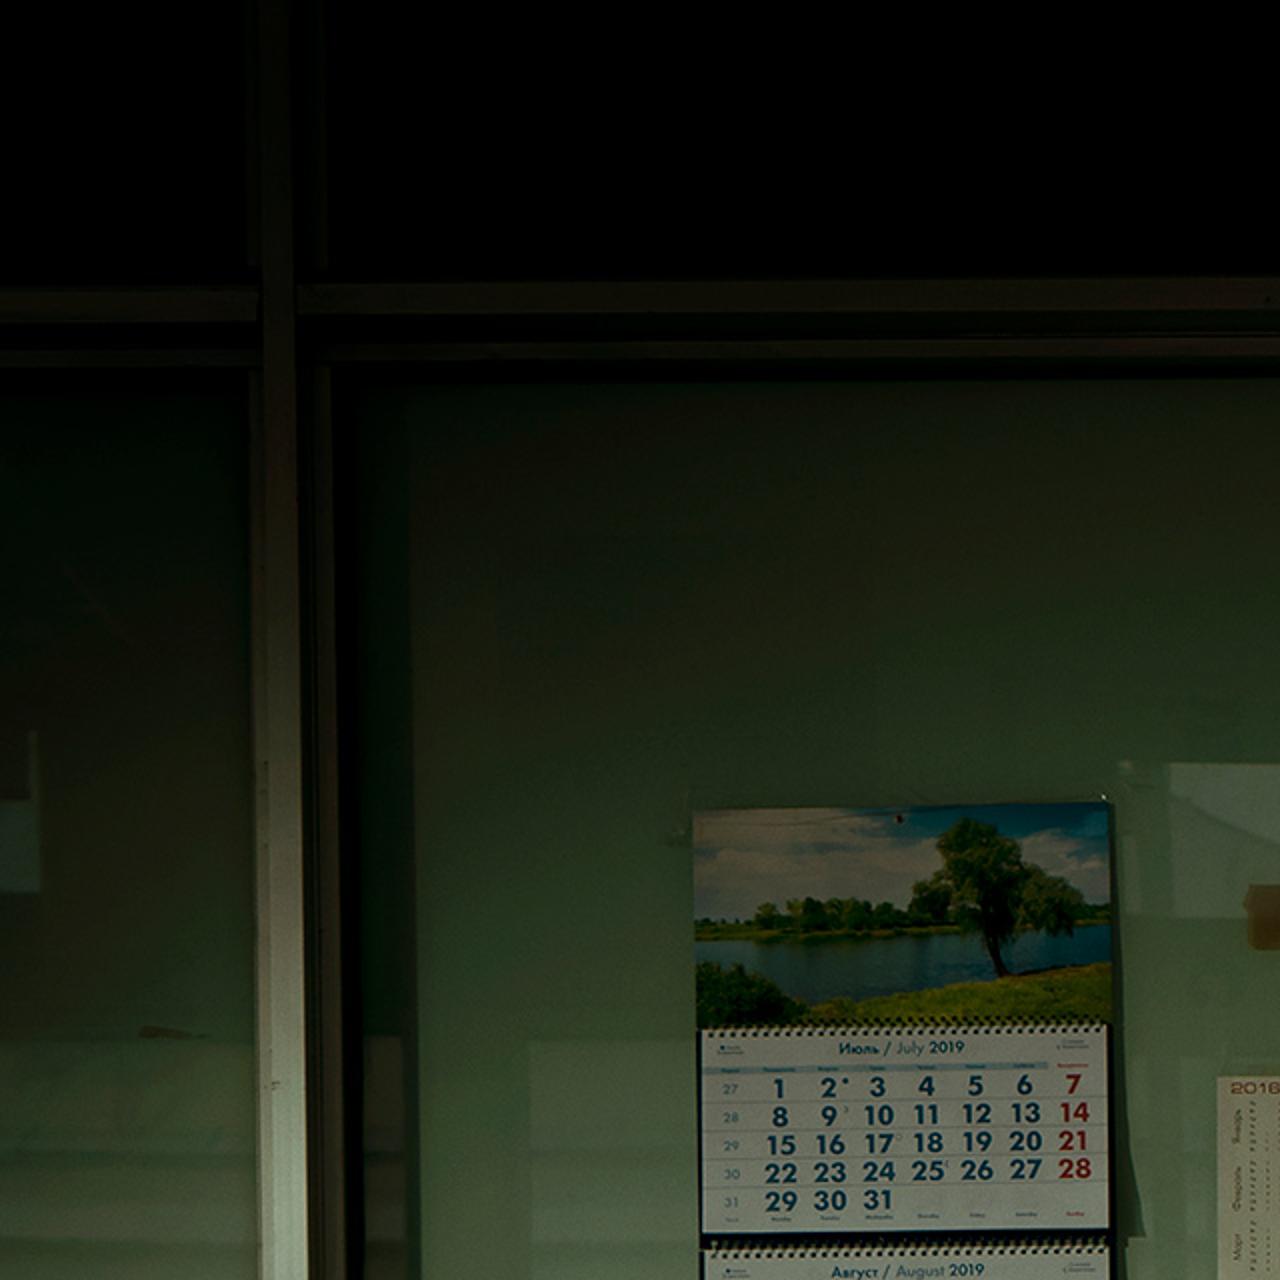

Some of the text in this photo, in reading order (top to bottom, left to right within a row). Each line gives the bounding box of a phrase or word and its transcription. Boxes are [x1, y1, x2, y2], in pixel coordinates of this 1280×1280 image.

[839, 1042, 879, 1056] Июль
[896, 1041, 925, 1059] July
[928, 1041, 965, 1055] 2019
[774, 1078, 783, 1099] 1
[821, 1077, 836, 1098] 2
[870, 1076, 886, 1097] 3
[919, 1076, 935, 1096] 4
[968, 1075, 983, 1096] 5
[1017, 1074, 1033, 1095] 6
[1066, 1074, 1081, 1095] 7
[1231, 1082, 1280, 1095] 2016
[772, 1106, 789, 1127] 8
[821, 1105, 837, 1127] 9
[865, 1104, 894, 1125] 10
[915, 1104, 938, 1125] 11
[963, 1103, 991, 1124] 12
[1012, 1102, 1041, 1123] 13
[1061, 1102, 1089, 1123] 14
[767, 1135, 796, 1155] 15
[817, 1134, 845, 1155] 16
[865, 1133, 894, 1154] 17
[914, 1132, 943, 1153] 18
[964, 1131, 992, 1152] 19
[1009, 1131, 1042, 1151] 20
[1059, 1130, 1086, 1151] 21
[765, 1163, 797, 1184] 22
[814, 1162, 846, 1183] 23
[863, 1161, 895, 1182] 24
[911, 1160, 945, 1181] 25
[961, 1159, 993, 1181] 26
[1010, 1159, 1042, 1179] 27
[1059, 1158, 1091, 1179] 28
[766, 1191, 797, 1212] 29
[814, 1190, 847, 1211] 30
[864, 1190, 891, 1210] 31
[949, 1263, 985, 1277] 2019
